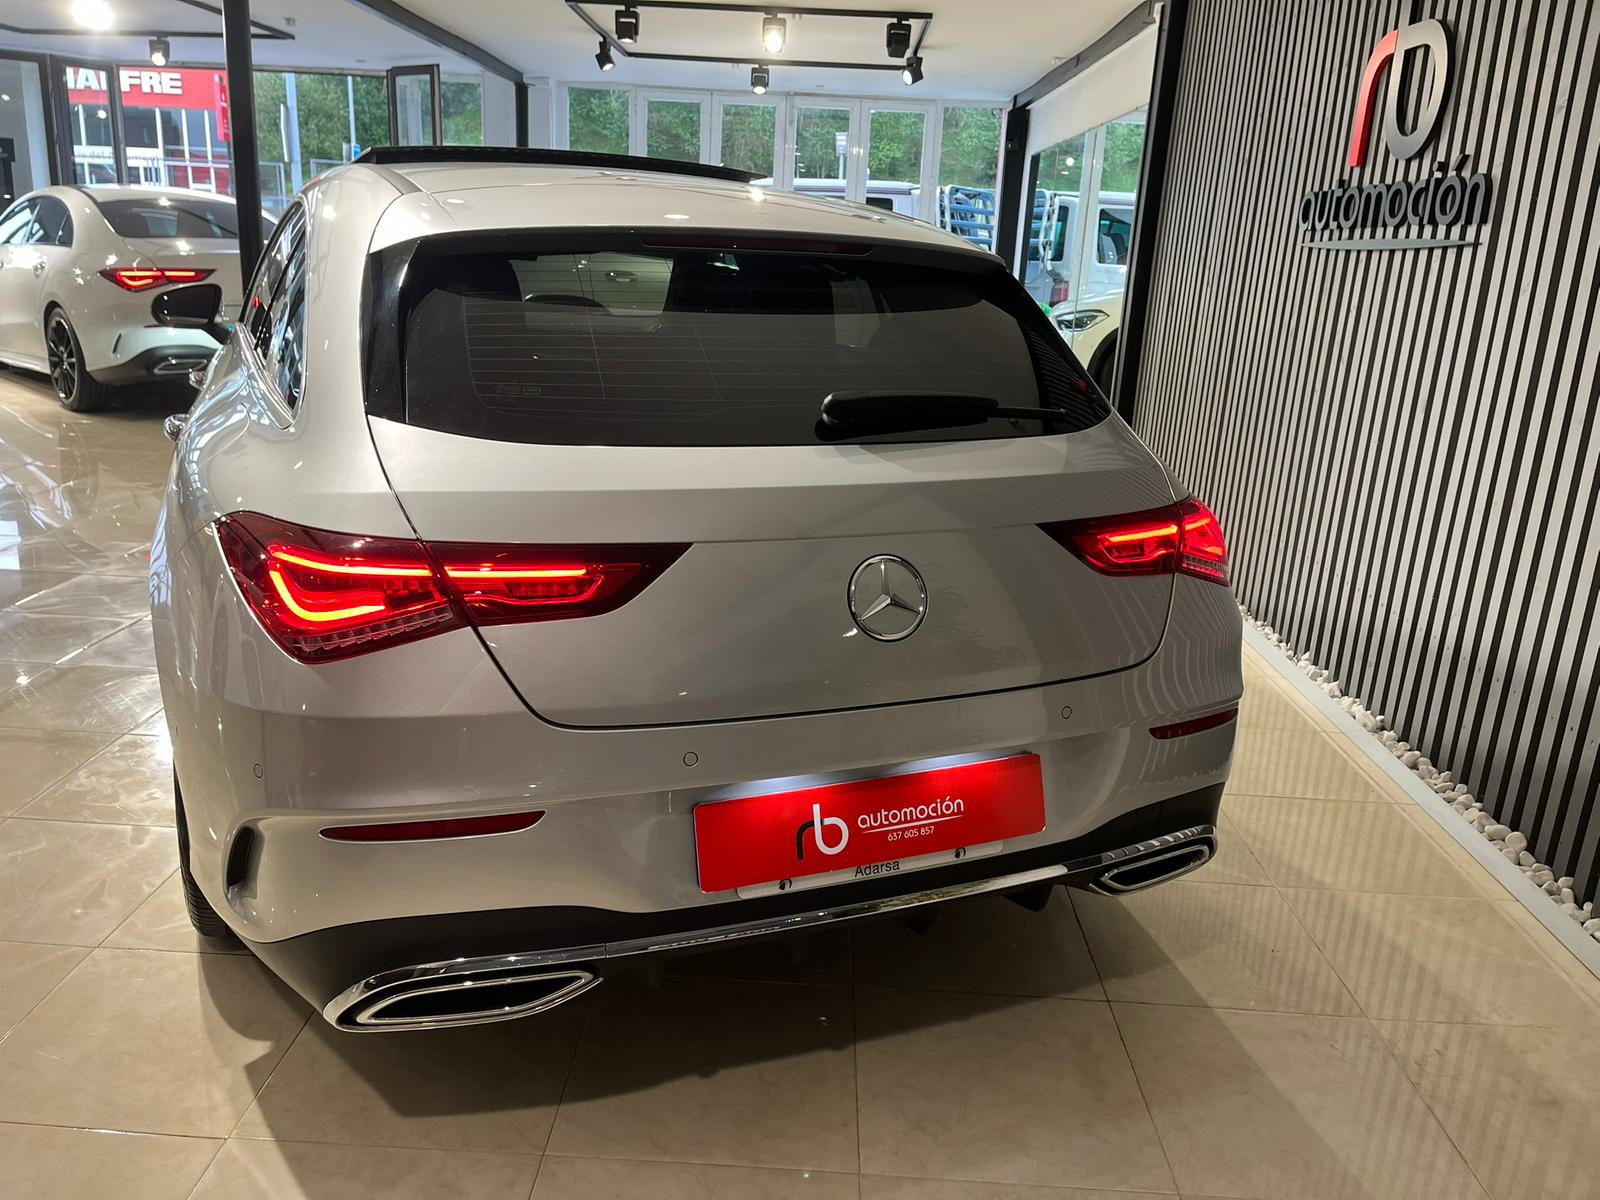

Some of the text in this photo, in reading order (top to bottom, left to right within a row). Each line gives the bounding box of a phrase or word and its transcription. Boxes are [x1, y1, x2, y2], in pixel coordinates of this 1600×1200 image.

[1299, 154, 1489, 231] automoción
[796, 796, 964, 860] rb automoción
[887, 826, 935, 841] 637 605 857
[854, 860, 900, 878] Adarsa
